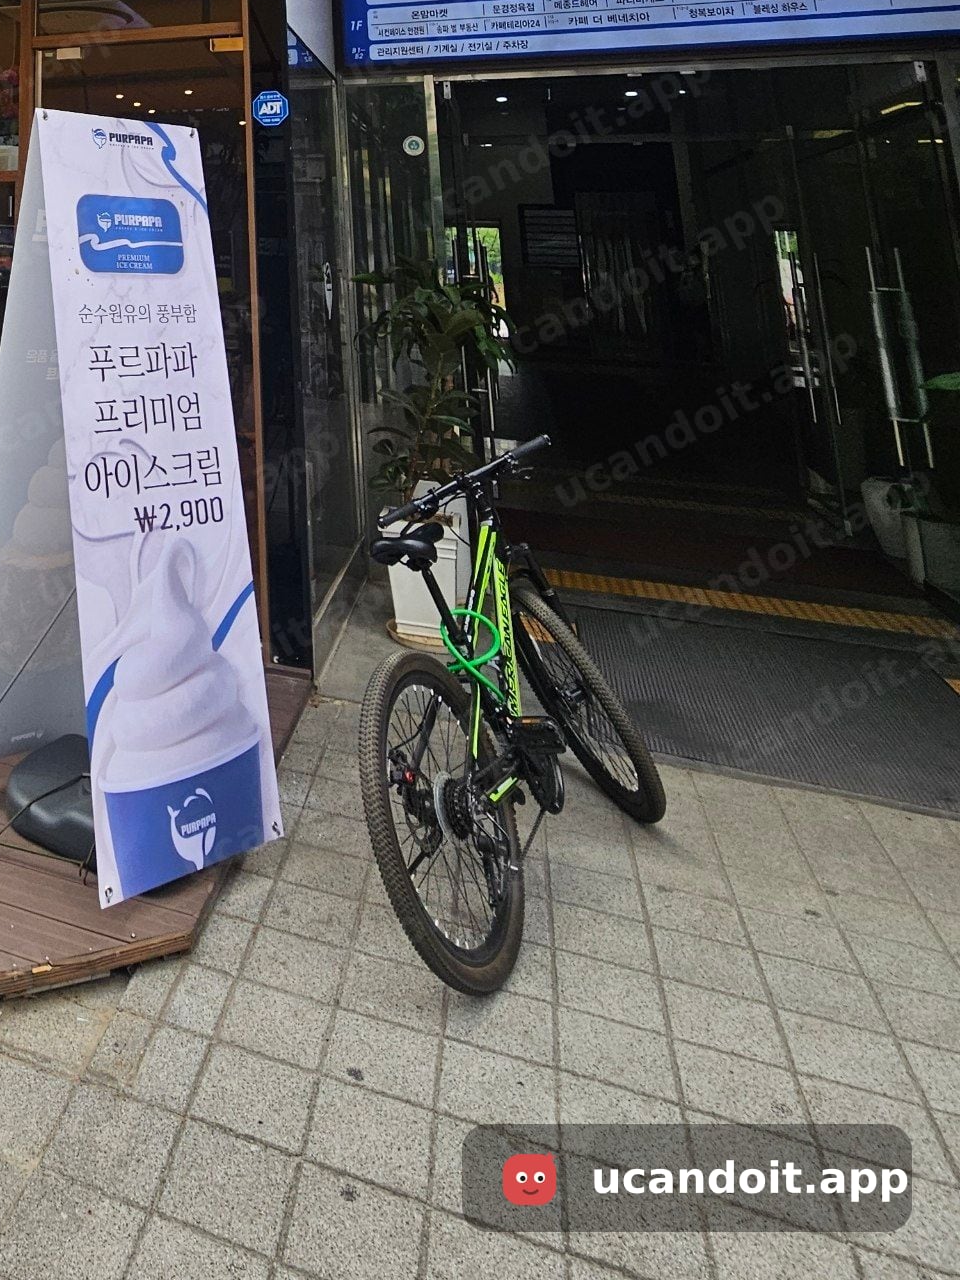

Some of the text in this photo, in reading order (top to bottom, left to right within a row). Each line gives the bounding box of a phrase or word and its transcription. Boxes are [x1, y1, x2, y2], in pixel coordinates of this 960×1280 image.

[753, 0, 808, 15] 블레싱 하우스
[491, 19, 540, 30] 카페테리아24
[568, 15, 589, 25] 카페
[607, 11, 650, 24] 베네치아
[350, 21, 363, 31] 1F
[377, 39, 529, 56] 관리지원센터 기계실 전기실 주차장
[258, 101, 282, 116] ADT
[109, 132, 153, 147] PURPAPA
[114, 213, 162, 227] PURPAPA
[118, 253, 150, 262] PREMIUM
[116, 261, 153, 270] ICE CREAM
[78, 303, 197, 324] 순수원유의 풍부함
[88, 341, 198, 383] 푸르파파
[94, 392, 202, 434] 프리미엄
[84, 446, 222, 499] 아이스크림
[134, 496, 224, 534] ₩2,900
[181, 812, 217, 837] PURPAPA
